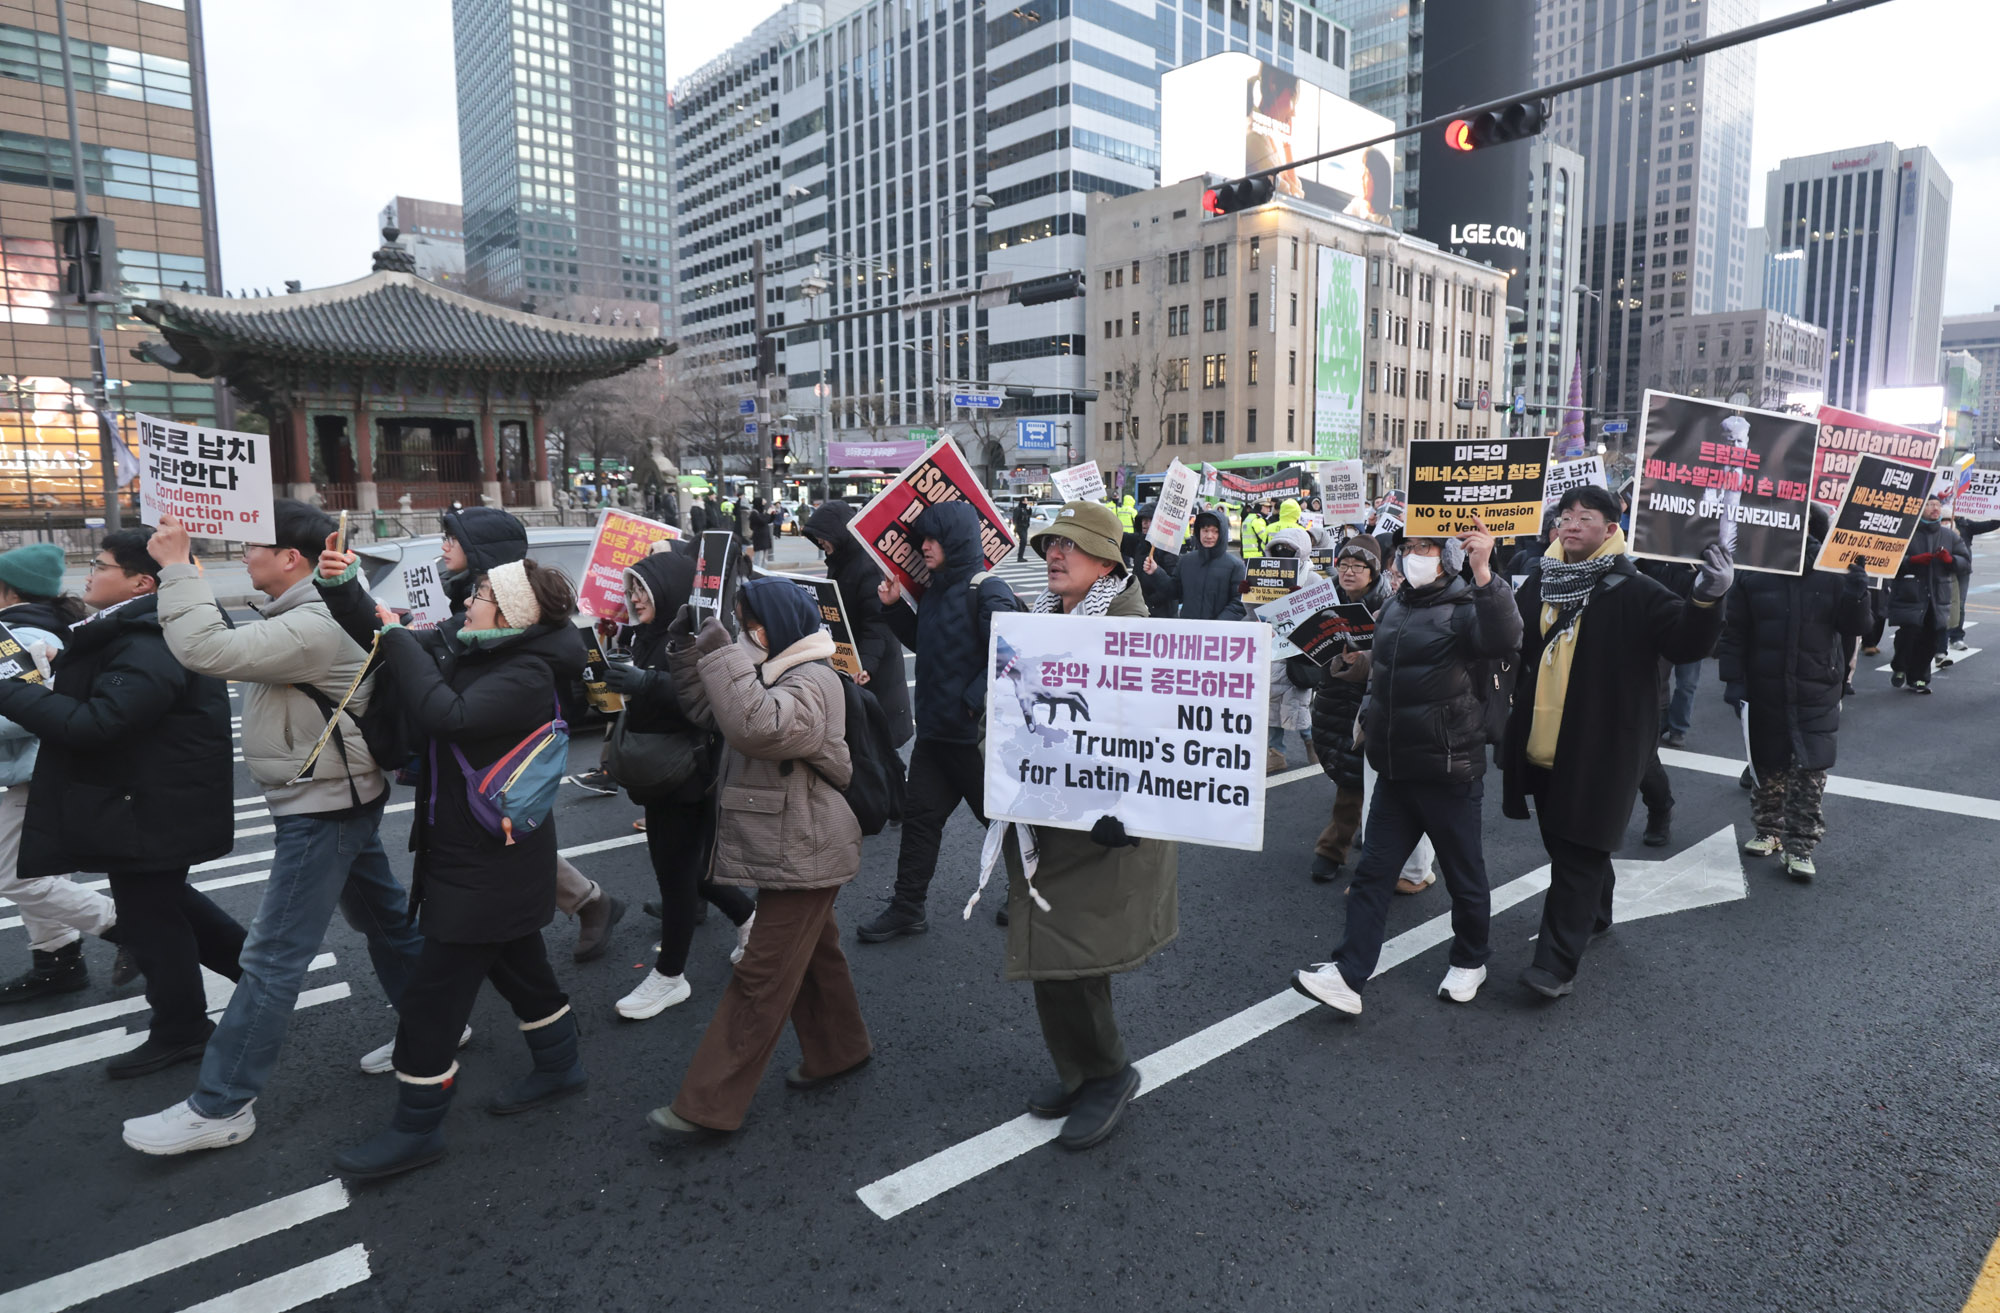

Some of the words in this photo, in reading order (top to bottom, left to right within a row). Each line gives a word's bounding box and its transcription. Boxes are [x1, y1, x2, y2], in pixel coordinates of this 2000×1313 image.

[1450, 223, 1526, 250] LGE.COM
[141, 421, 189, 456] 마두로
[198, 433, 255, 464] 납치
[1454, 444, 1508, 461] 미국의
[1818, 424, 1937, 460] Solidaridad
[1699, 441, 1761, 470] 트럼프는
[149, 453, 239, 491] 규탄한다
[1330, 474, 1351, 483] 미국의
[1415, 465, 1504, 482] 베네수엘라
[1507, 463, 1541, 480] 침공
[1569, 461, 1597, 478] 납치
[1644, 458, 1754, 493] 베네수엘라에서
[1757, 477, 1774, 497] 손
[1776, 479, 1808, 502] 떼라
[1881, 467, 1914, 490] 미국의
[156, 482, 222, 505] Condemn
[1221, 488, 1246, 500] HANDS
[1261, 487, 1300, 499] VENEZUELA
[1325, 483, 1358, 492] 베네수엘라
[1337, 492, 1360, 501] 규탄한다
[1443, 484, 1513, 502] 규탄한다
[157, 500, 235, 521] abduction
[240, 510, 260, 523] of
[1415, 507, 1435, 518] NO
[1439, 507, 1452, 518] to
[1456, 507, 1481, 519] U.S.
[1484, 505, 1534, 518] invasion
[1649, 492, 1696, 516] HANDS
[1699, 500, 1725, 520] OFF
[1727, 505, 1801, 531] VENEZUELA
[1851, 486, 1905, 512] 베네수엘라
[1903, 496, 1924, 516] 침공
[1437, 522, 1450, 532] of
[1859, 511, 1902, 534] 규탄한다
[602, 531, 629, 549] 민중
[1832, 531, 1848, 544] NO
[1848, 535, 1857, 546] to
[1857, 537, 1873, 548] U.S.
[1874, 538, 1905, 553] invasion
[1260, 560, 1280, 568] 미국의
[1839, 550, 1850, 562] of
[410, 566, 433, 587] 납치
[1247, 568, 1279, 578] 베네수엘라
[1280, 569, 1295, 578] 침공
[1256, 578, 1284, 586] 규탄한다
[1289, 582, 1331, 606] 라틴아메리카
[1275, 610, 1290, 621] 장악
[1292, 604, 1305, 615] 시도
[1306, 592, 1334, 609] 중단하라
[1104, 631, 1256, 663] 라틴아메리카
[1279, 641, 1290, 649] for
[1310, 638, 1333, 657] HANDS
[1333, 631, 1346, 641] OFF
[1041, 661, 1090, 688] 장악
[1096, 665, 1143, 692] 시도
[1151, 668, 1255, 700] 중단하라
[1178, 705, 1212, 732] NO
[1221, 708, 1253, 734] to
[1072, 730, 1175, 763] Trump's
[1183, 740, 1251, 771] Grab
[1019, 759, 1057, 785] for
[1065, 763, 1130, 792] Latin
[1137, 770, 1249, 807] America
